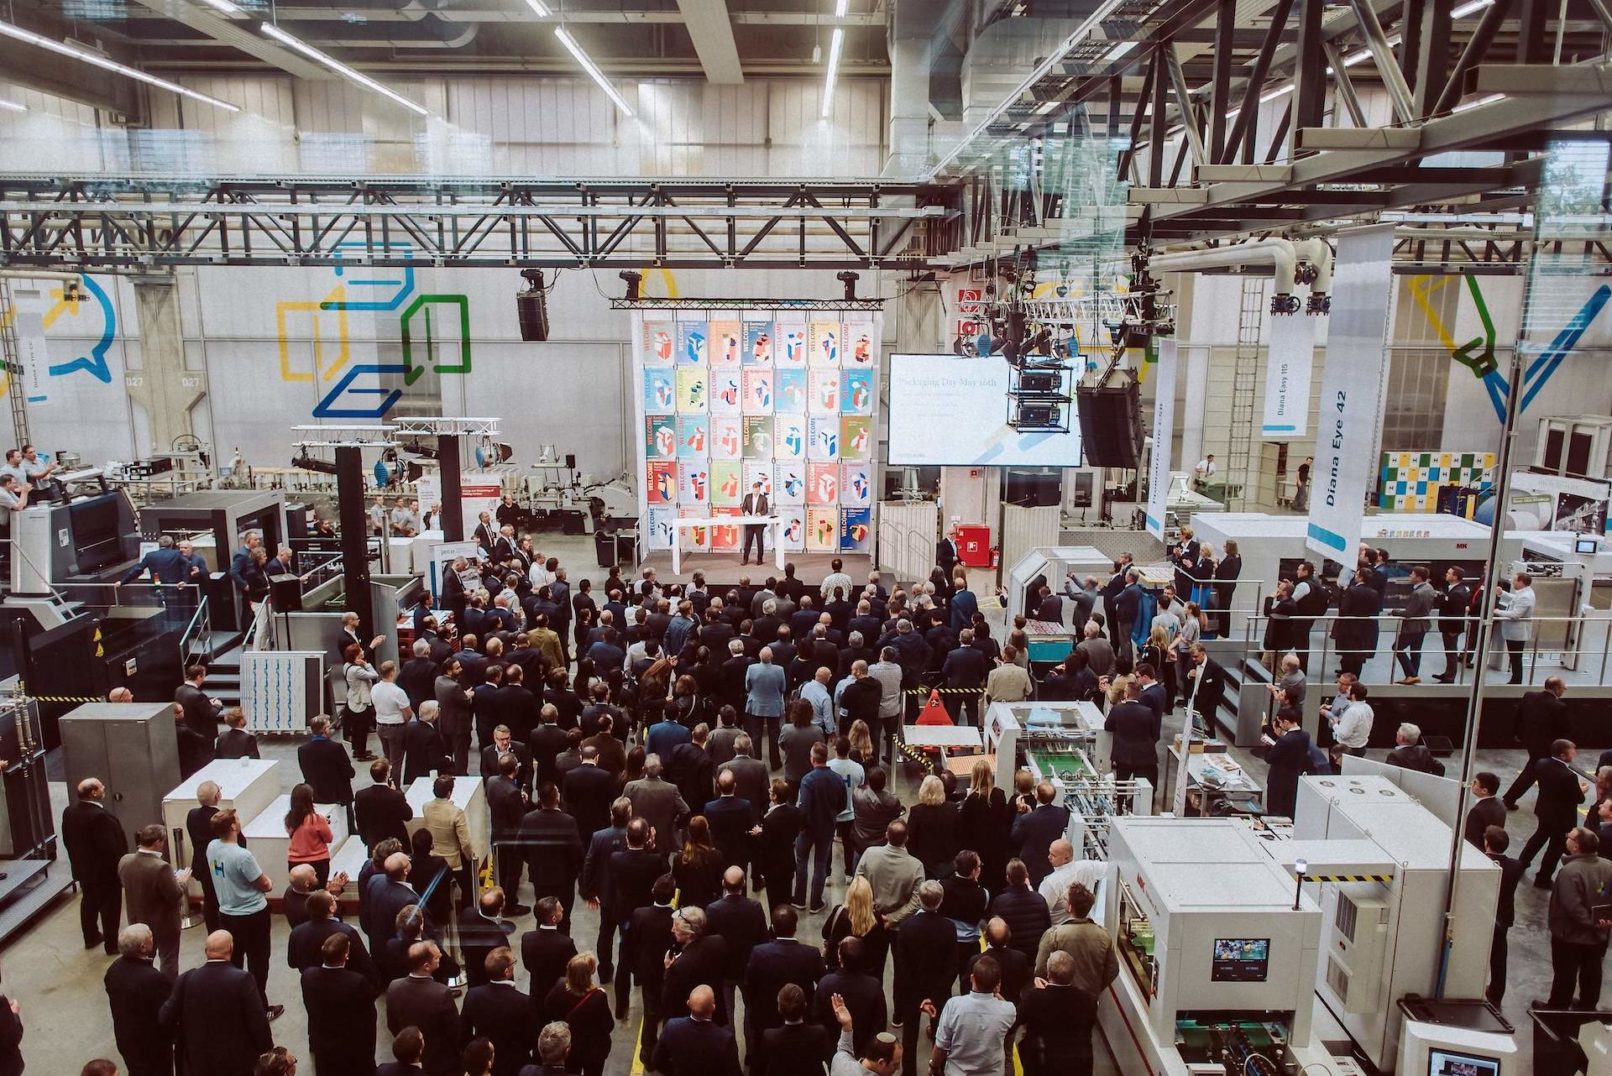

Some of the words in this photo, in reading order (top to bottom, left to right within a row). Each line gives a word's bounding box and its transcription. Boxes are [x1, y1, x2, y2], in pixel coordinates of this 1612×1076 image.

[1279, 376, 1288, 393] Easy
[1337, 390, 1346, 413] 42
[1332, 419, 1343, 449] Eye
[1326, 456, 1339, 507] Diana
